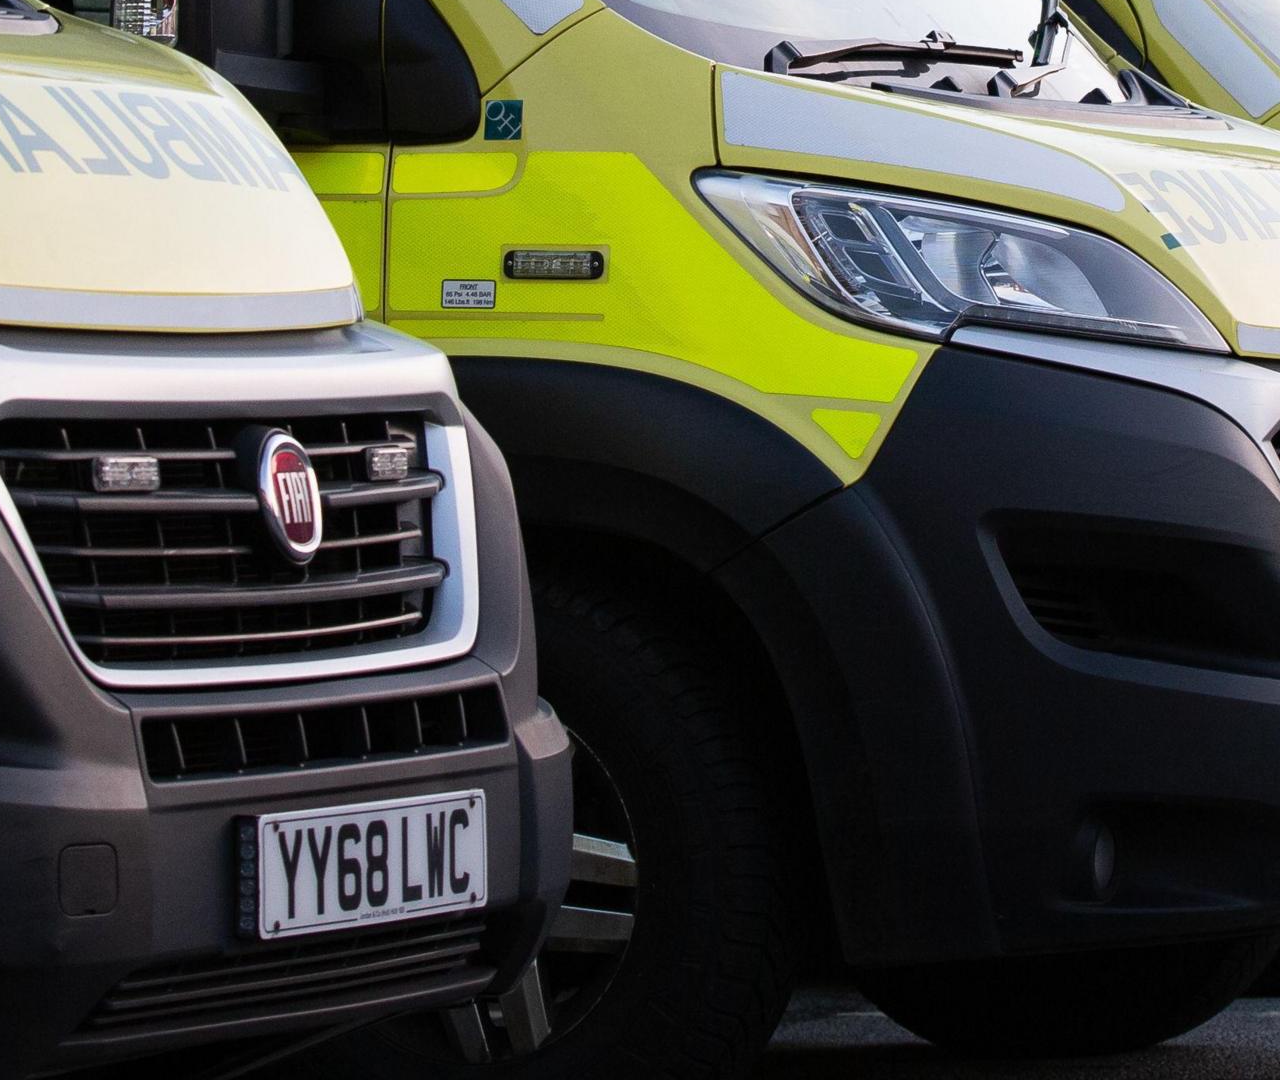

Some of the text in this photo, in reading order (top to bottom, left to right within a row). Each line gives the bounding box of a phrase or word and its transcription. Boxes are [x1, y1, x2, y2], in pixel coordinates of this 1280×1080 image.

[459, 283, 479, 291] FRONT
[276, 471, 313, 525] FIAT
[278, 808, 471, 920] YY68 LWC
